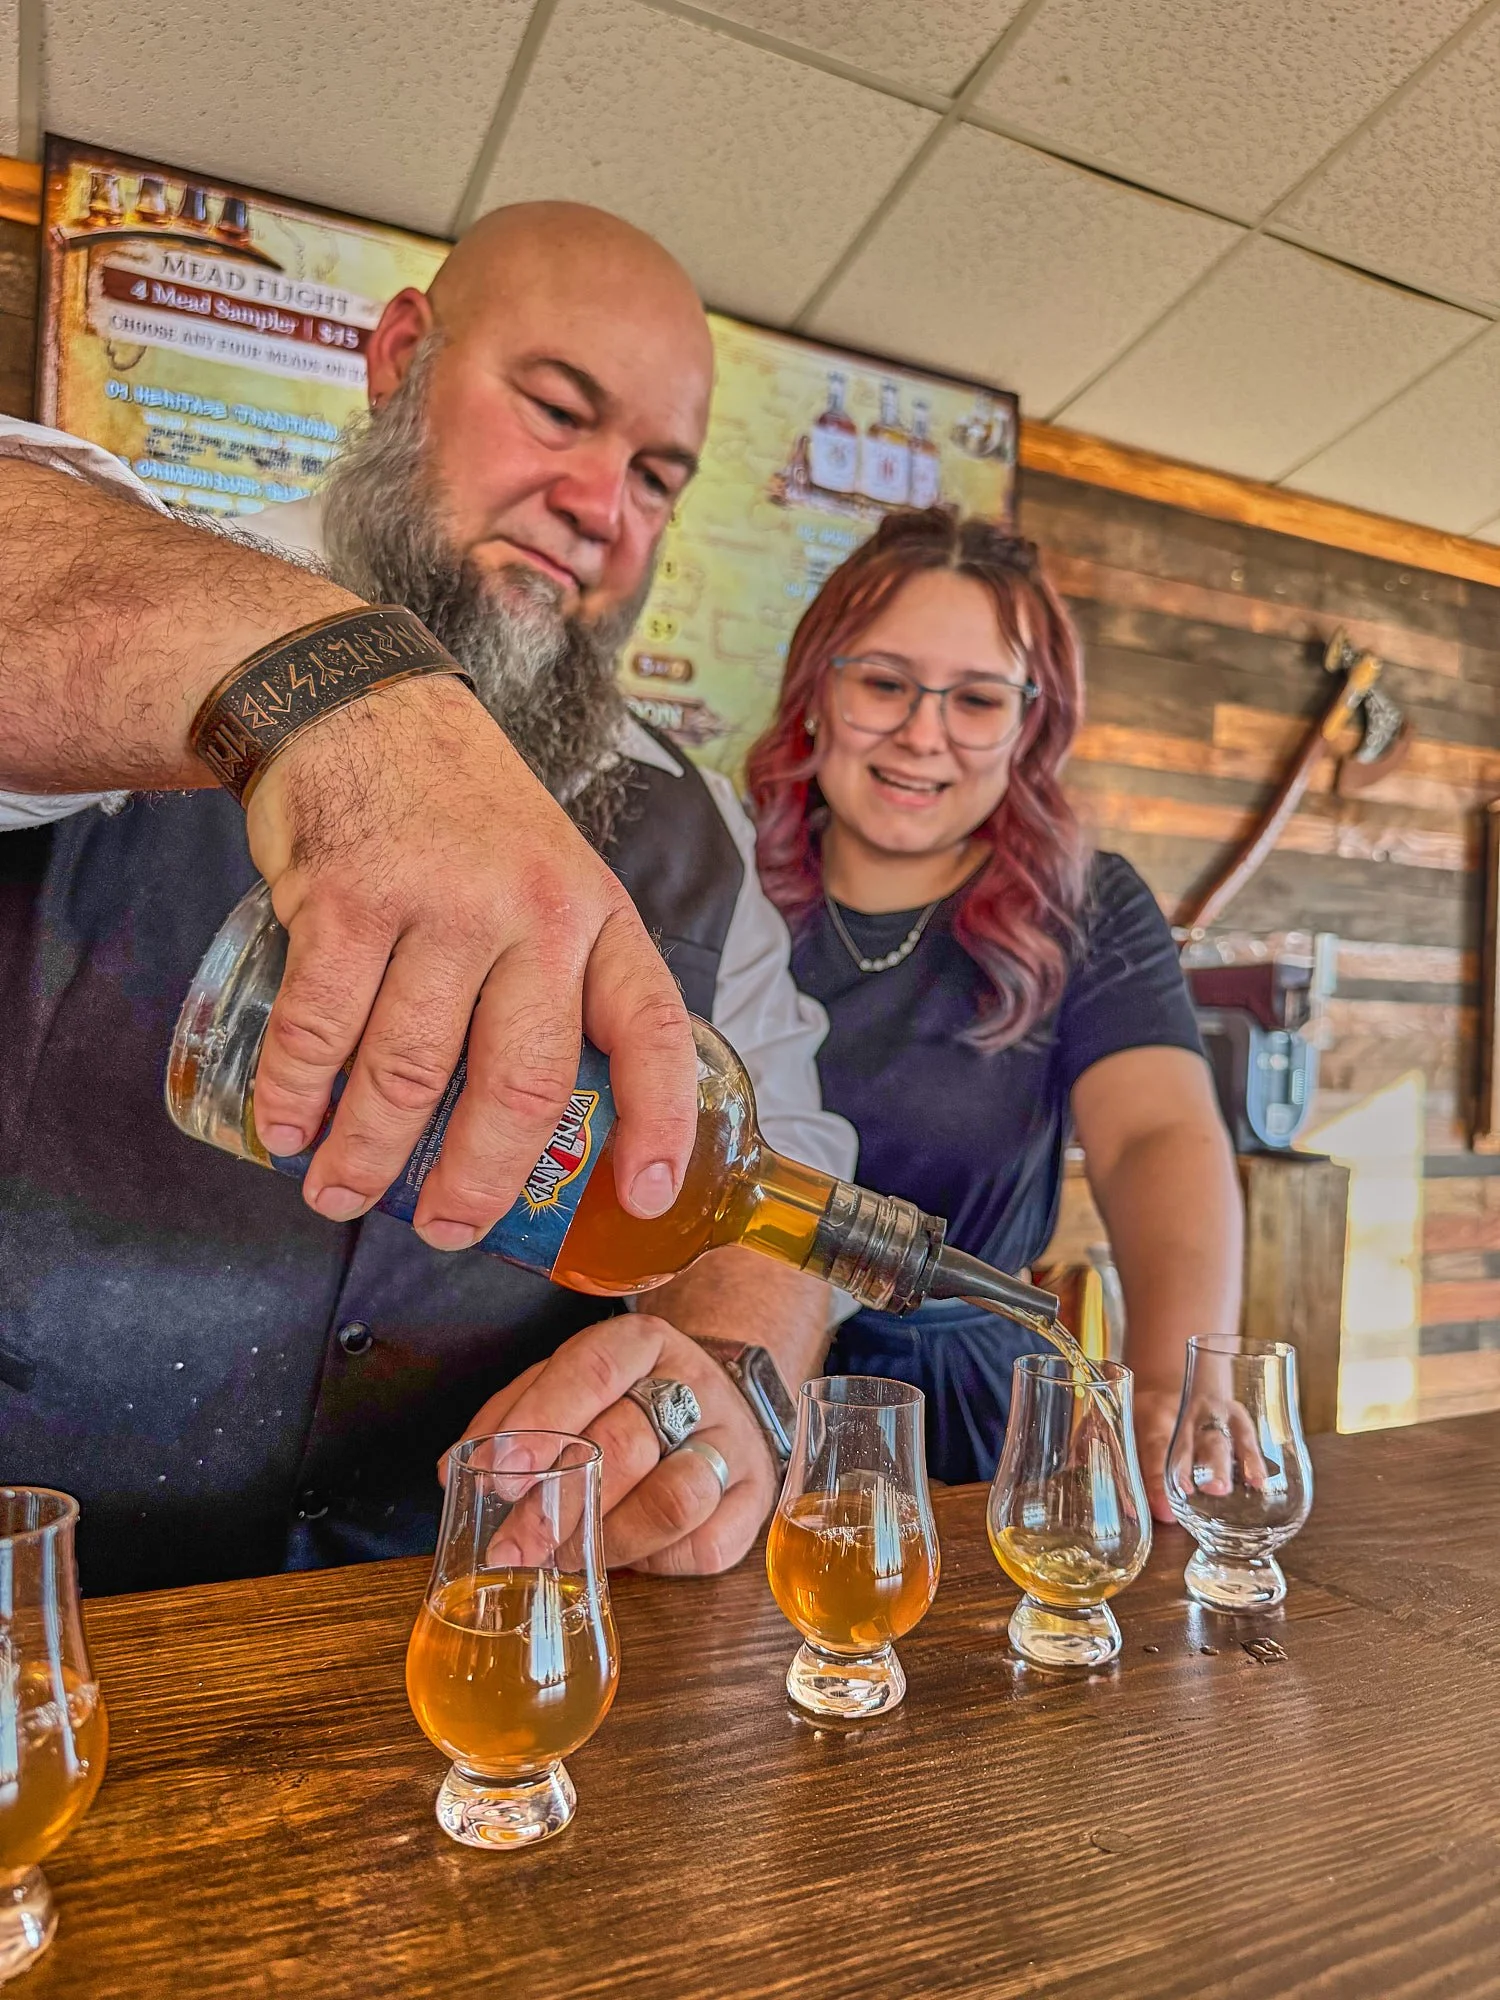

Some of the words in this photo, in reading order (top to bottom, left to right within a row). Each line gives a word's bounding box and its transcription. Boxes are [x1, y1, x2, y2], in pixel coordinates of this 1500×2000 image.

[130, 280, 148, 301] 4
[152, 282, 212, 318] Mead
[213, 299, 299, 336] Sampler
[160, 252, 246, 292] MEAD
[253, 277, 349, 317] FLIGHT
[110, 314, 178, 343] CHOOSE
[524, 1093, 594, 1203] VINLAND
